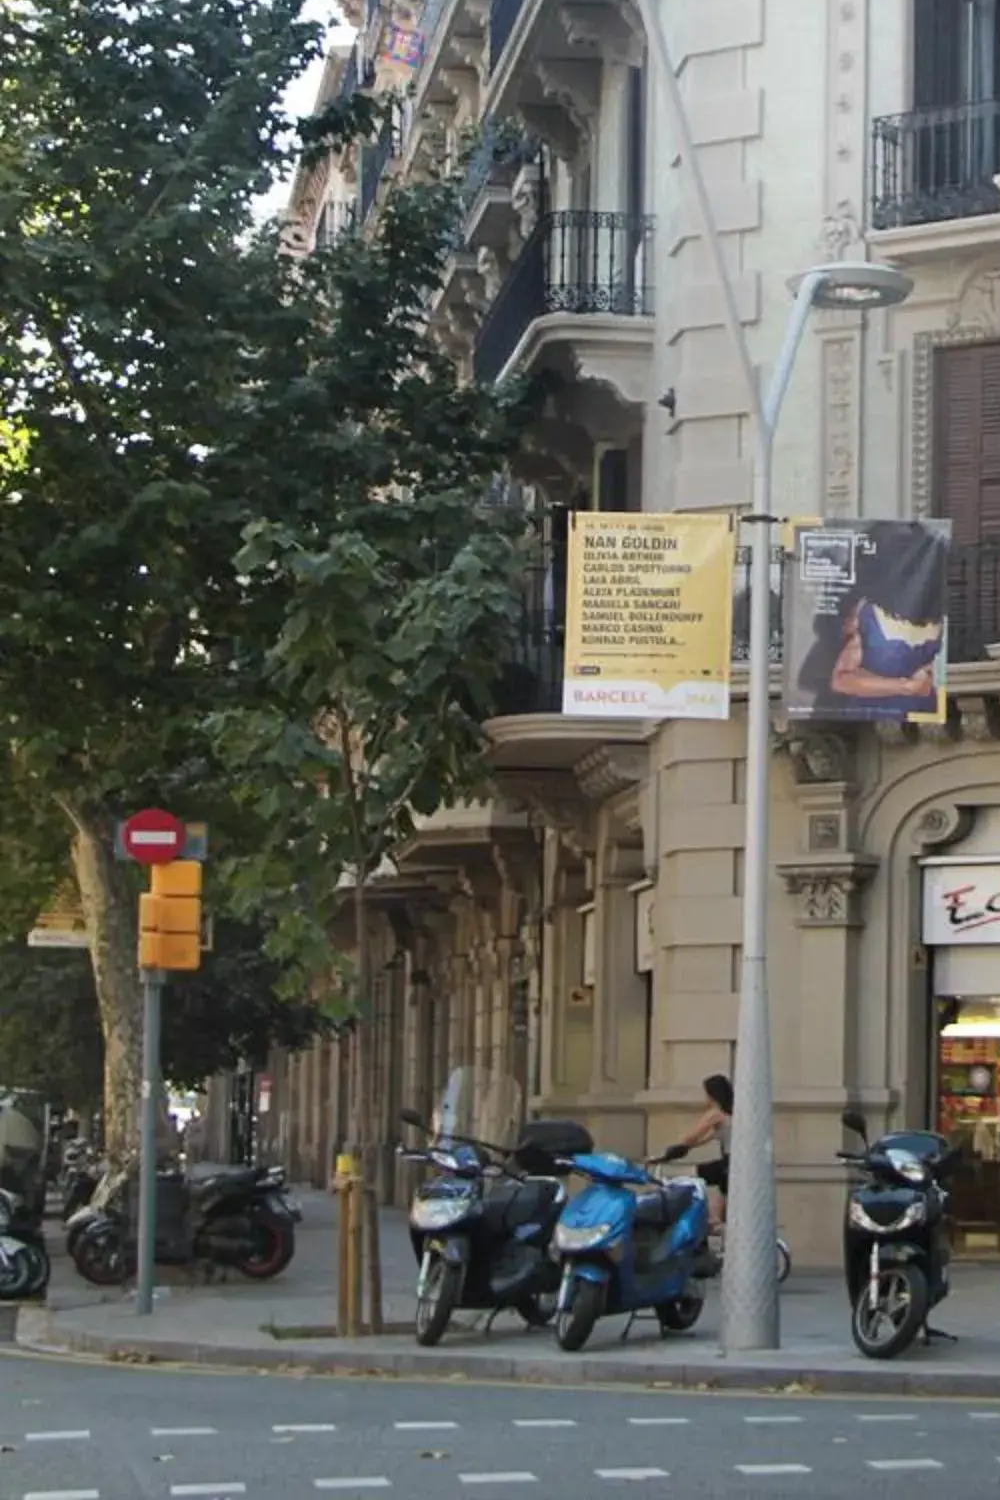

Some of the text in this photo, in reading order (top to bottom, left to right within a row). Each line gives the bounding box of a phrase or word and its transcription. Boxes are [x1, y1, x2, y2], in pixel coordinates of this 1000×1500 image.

[584, 535, 678, 550] NAN GOLDIN
[581, 611, 625, 621] SAMUEL
